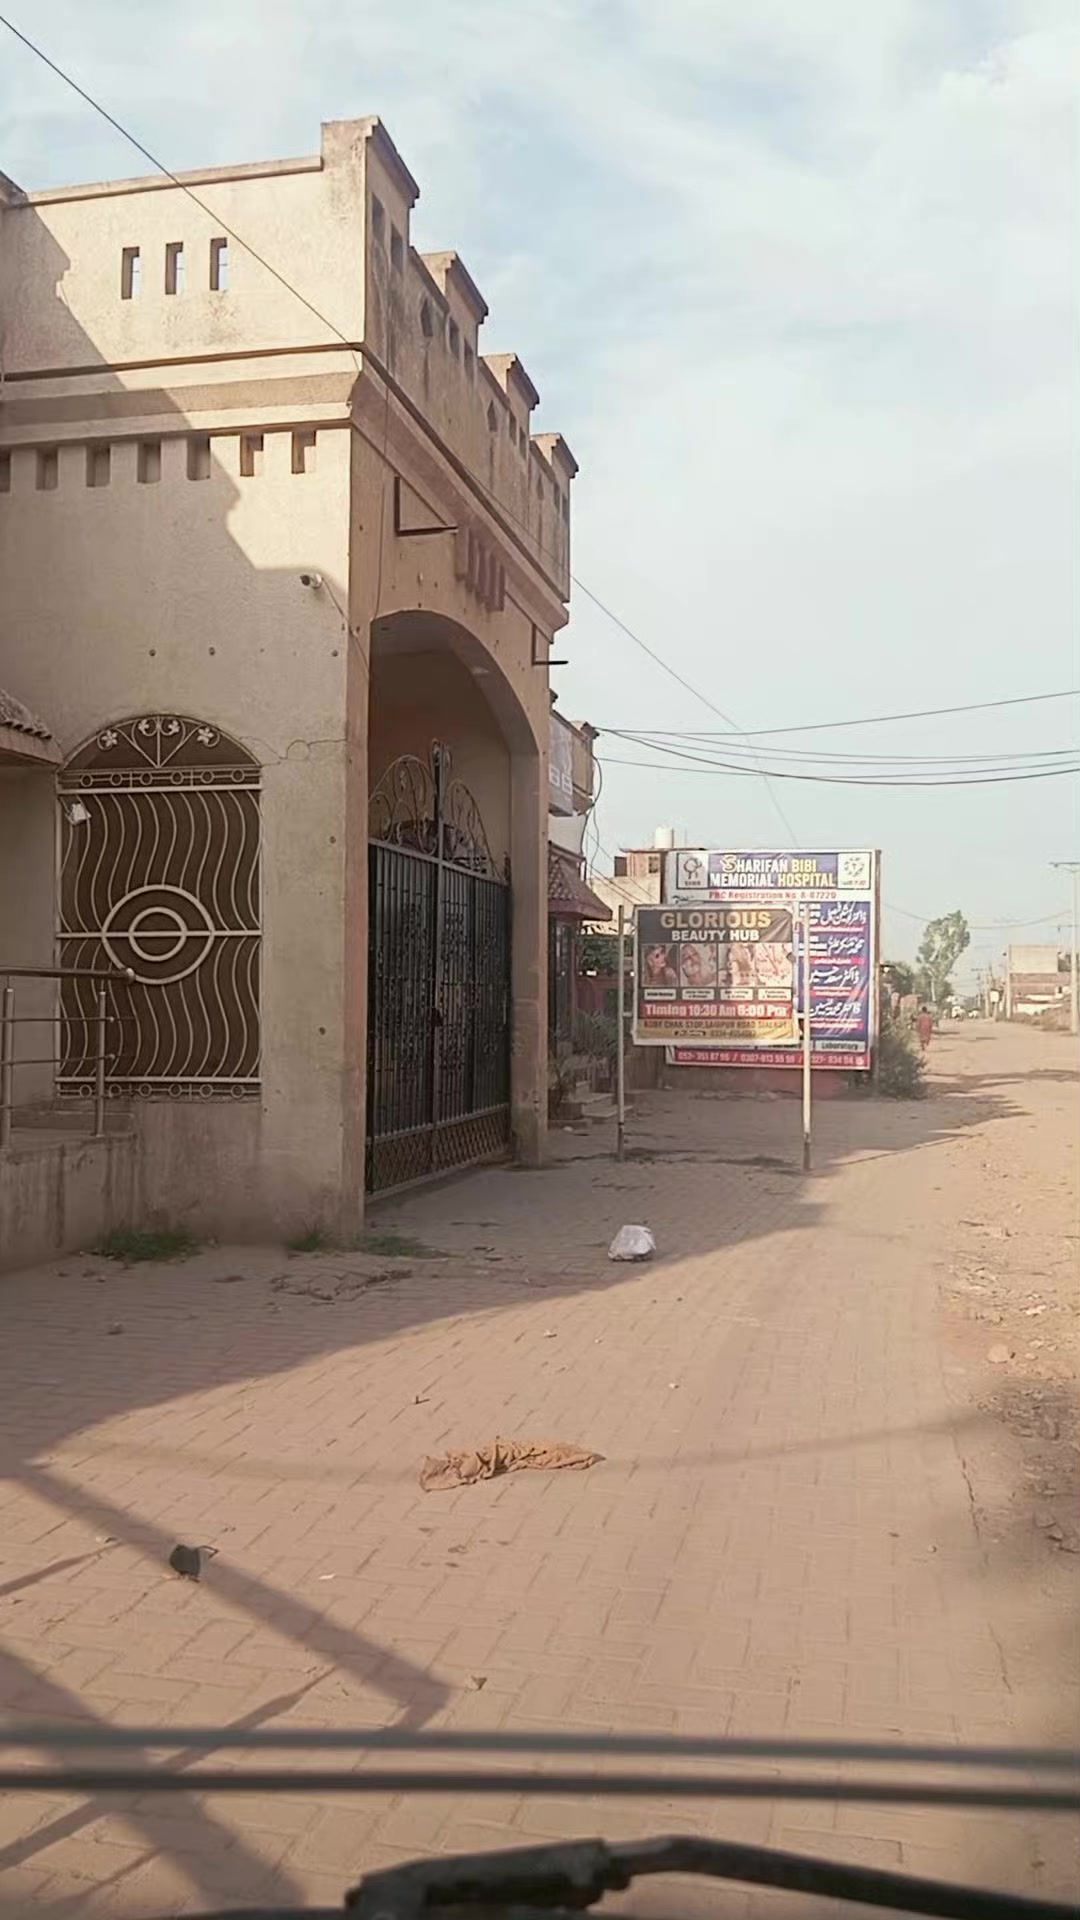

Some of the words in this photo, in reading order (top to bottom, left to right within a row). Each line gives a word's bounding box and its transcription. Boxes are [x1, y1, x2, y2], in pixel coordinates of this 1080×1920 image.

[722, 854, 788, 873] SHARIFAN
[791, 859, 817, 873] BIBI
[709, 873, 774, 887] MEMORIAL
[777, 873, 836, 887] HOSPITAL
[728, 891, 783, 900] Registration
[660, 911, 772, 928] GLORIOUS
[671, 930, 725, 941] BEAUTY
[729, 930, 760, 941] HUB
[645, 1004, 687, 1016] Timing
[689, 1004, 717, 1016] 10:30
[718, 1004, 736, 1016] Am
[737, 1004, 765, 1016] 6:00
[821, 1042, 859, 1051] Laboratory
